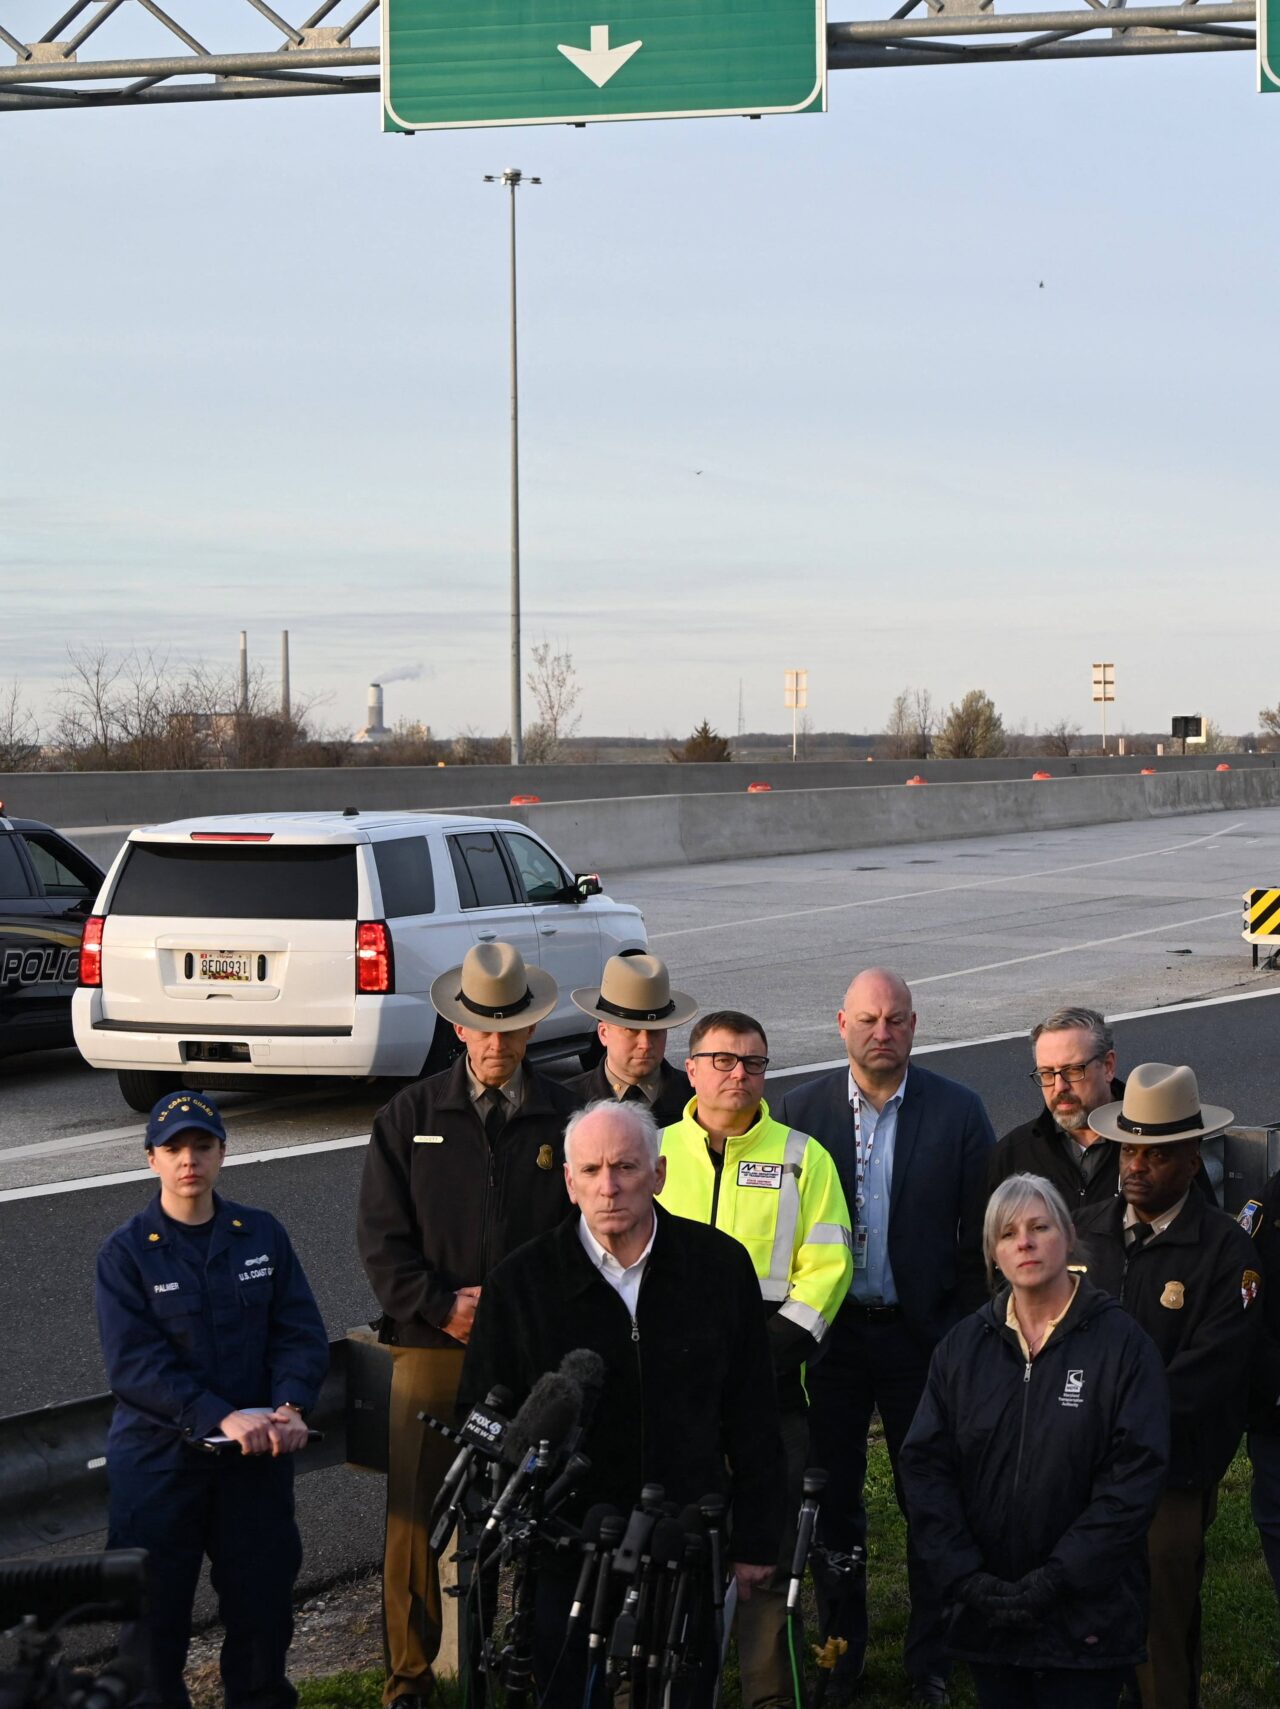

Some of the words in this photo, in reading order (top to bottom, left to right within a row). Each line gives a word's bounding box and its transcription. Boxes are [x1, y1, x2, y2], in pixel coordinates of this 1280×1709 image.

[1, 949, 80, 984] POLIC
[168, 1096, 191, 1110] COAST
[193, 1099, 214, 1117] GUARD
[250, 1268, 267, 1279] COAST
[471, 1413, 492, 1429] FOX
[467, 1423, 496, 1441] NEWS
